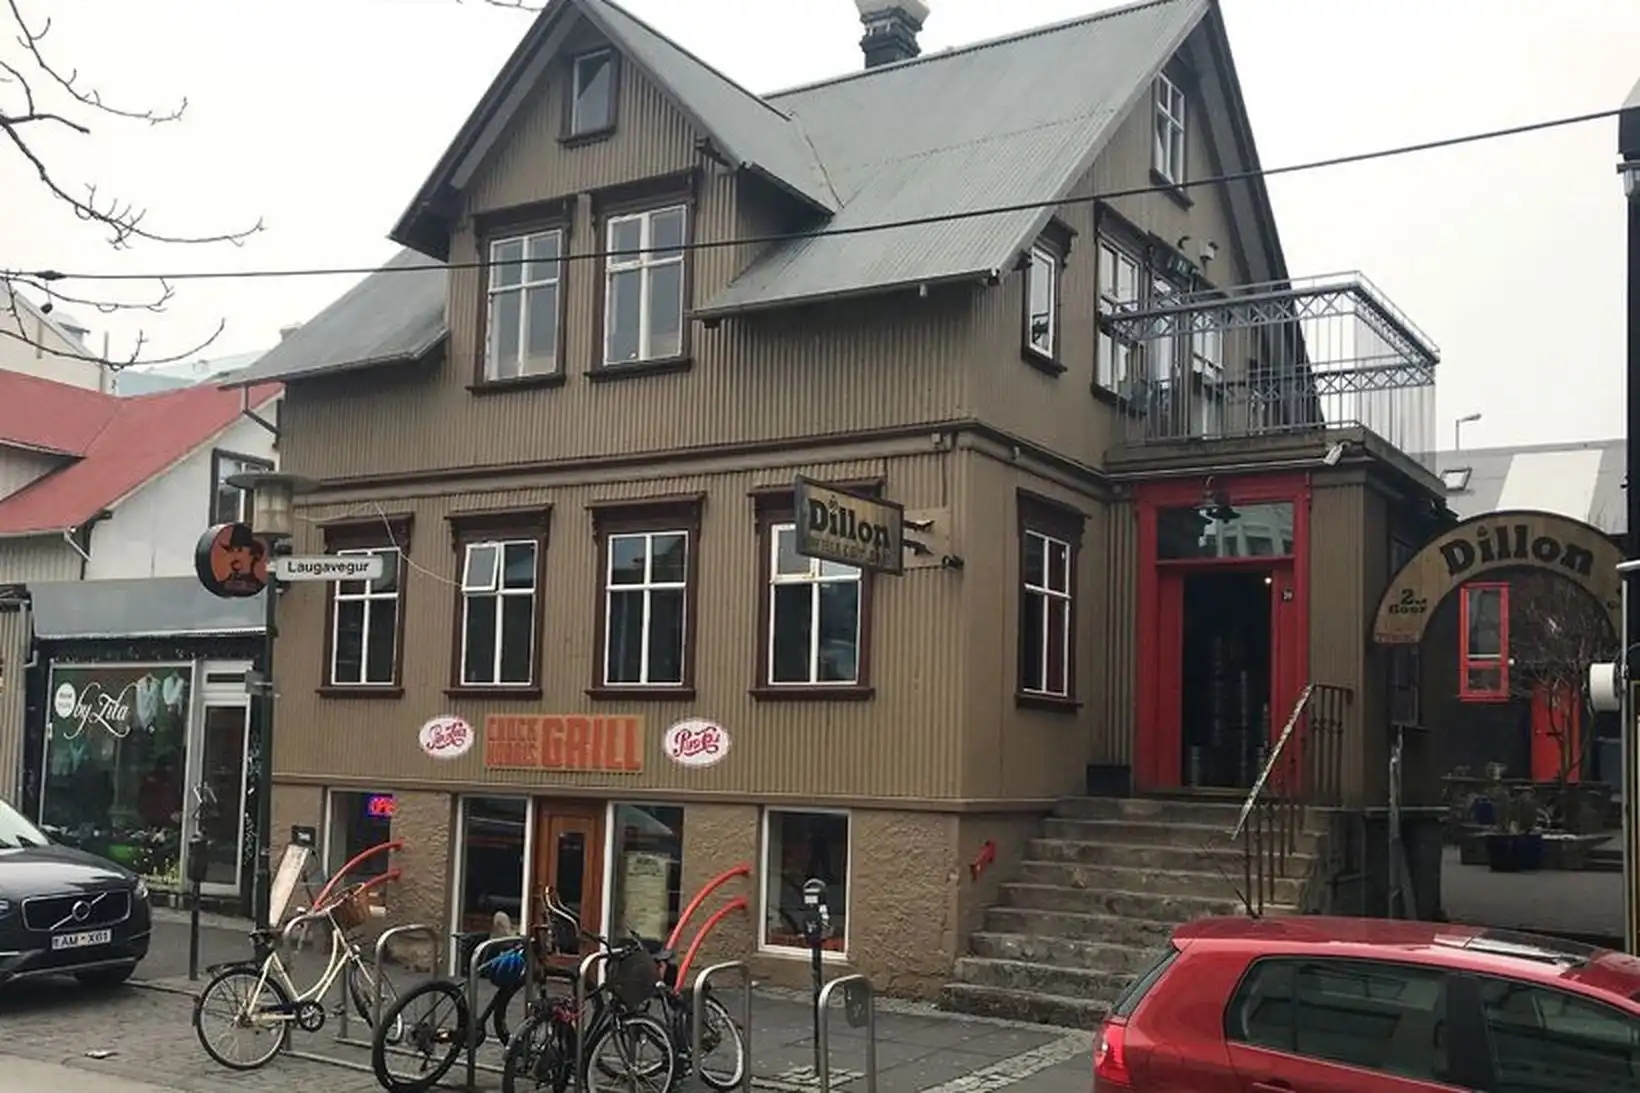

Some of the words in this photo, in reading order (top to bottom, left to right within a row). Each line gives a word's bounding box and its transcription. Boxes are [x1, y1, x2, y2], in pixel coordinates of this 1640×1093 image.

[808, 495, 891, 549] Dillon
[287, 561, 370, 575] Laugavegur
[1440, 525, 1594, 576] Dillon
[541, 717, 641, 770] GRILL
